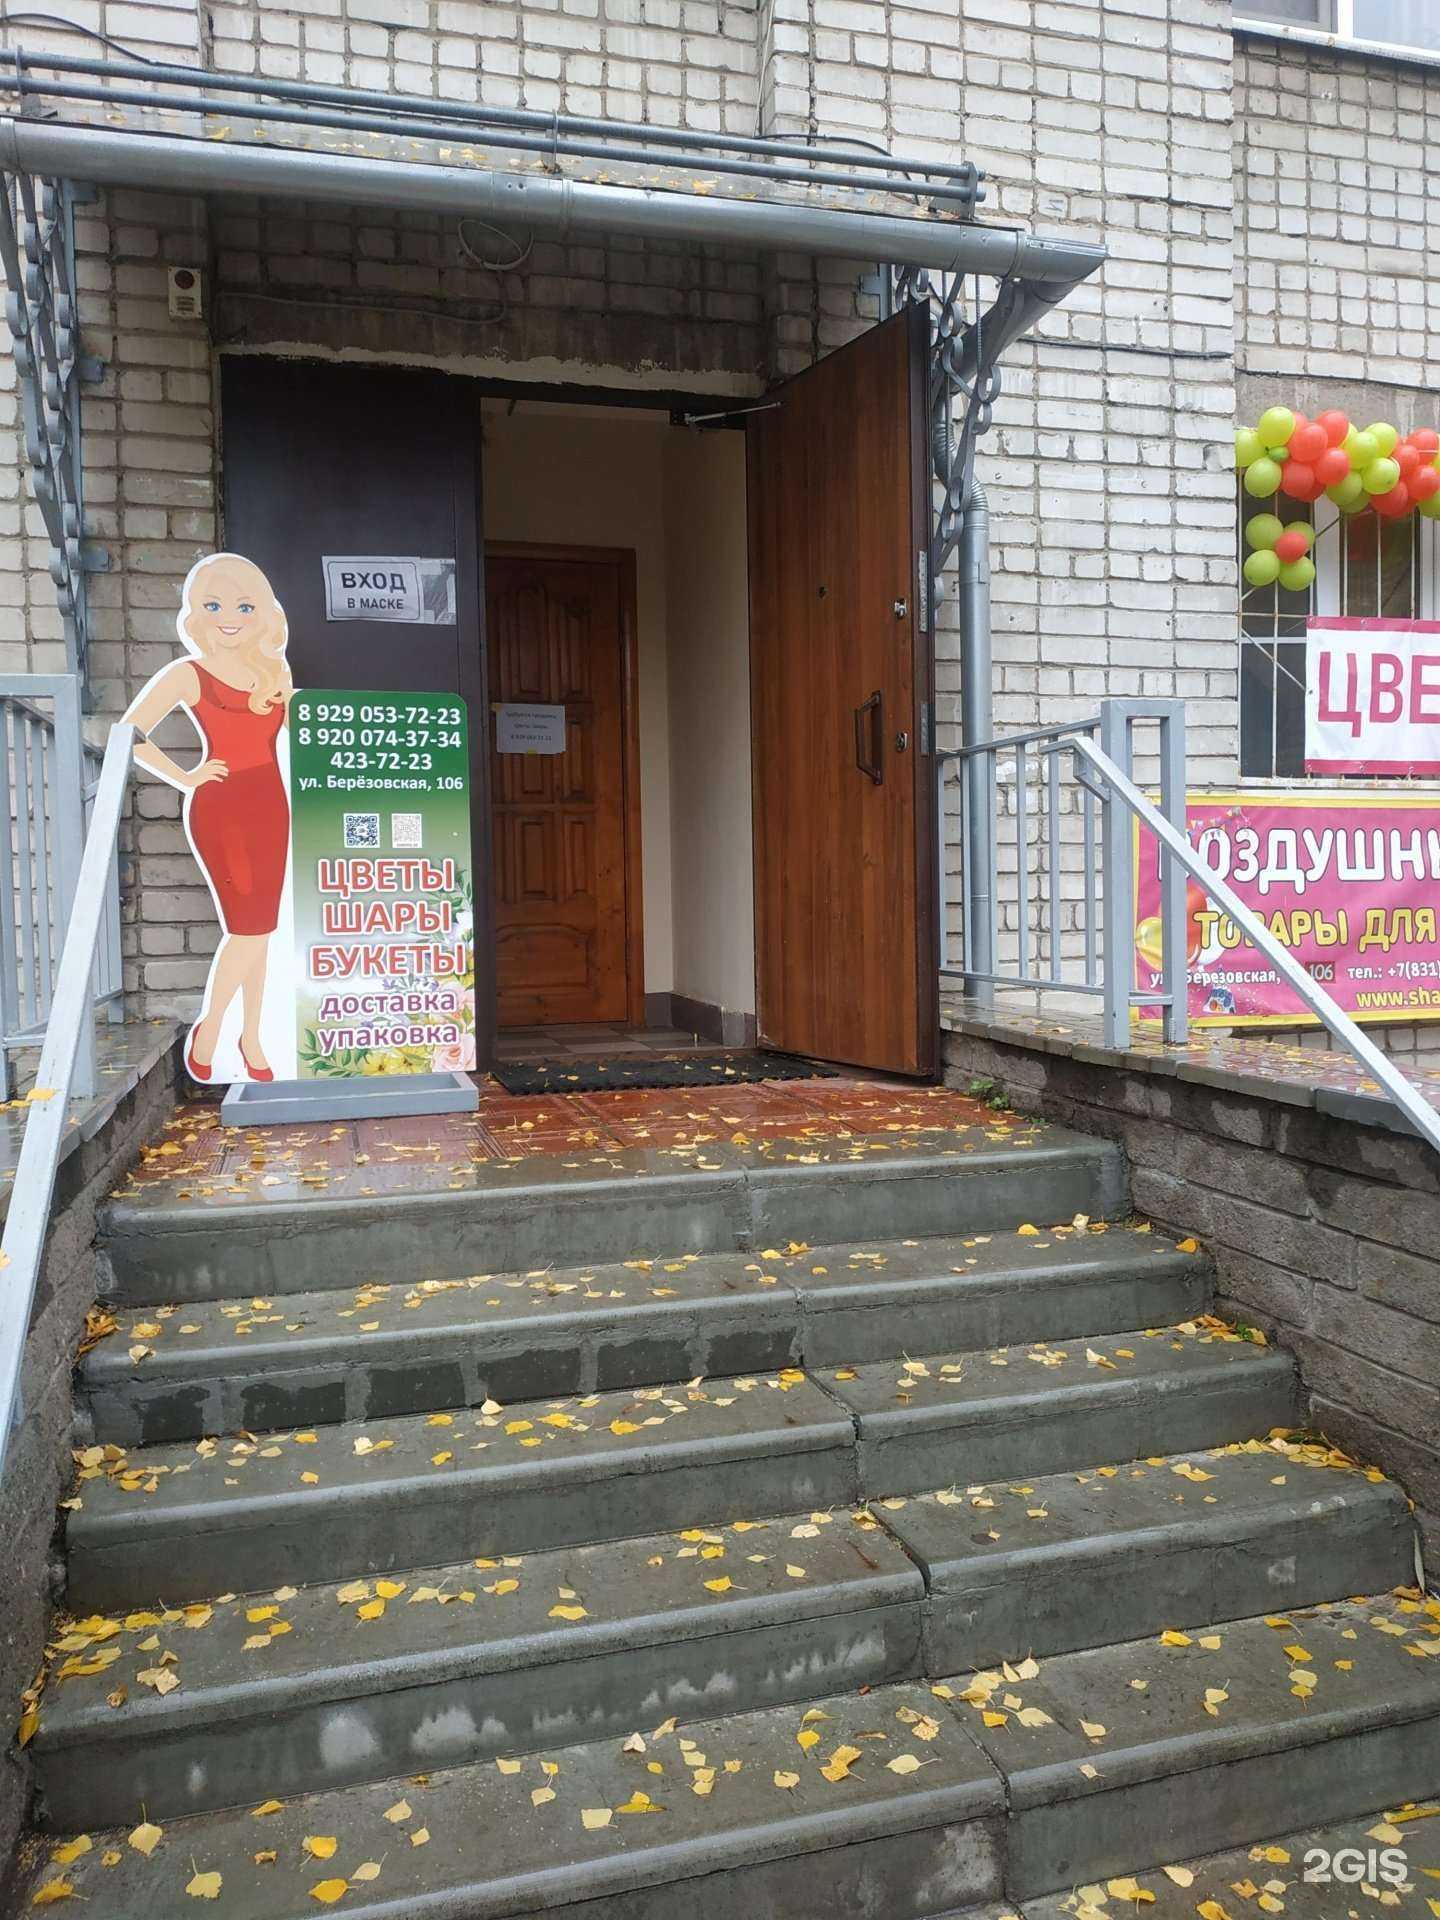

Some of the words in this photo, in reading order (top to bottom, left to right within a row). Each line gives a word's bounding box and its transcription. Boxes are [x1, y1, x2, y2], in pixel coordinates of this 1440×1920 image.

[341, 572, 406, 594] ВХОД
[347, 598, 356, 609] В
[360, 598, 404, 610] МАСКЕ
[1318, 650, 1440, 738] ЦВЕ
[298, 704, 311, 721] 8
[317, 704, 354, 722] 929
[360, 706, 461, 725] 053-72-23
[298, 728, 311, 745] 8
[317, 728, 355, 746] 920
[360, 729, 461, 748] 074-37-34
[330, 752, 432, 770] 423-72-23
[299, 777, 322, 790] ул.
[327, 775, 432, 791] Берёзовская,
[436, 776, 464, 790] 106
[1158, 827, 1440, 895] ОЗДУШН
[318, 859, 454, 898] ЦВЕТЫ
[323, 902, 451, 934] ШАРЫ
[1357, 907, 1438, 953] ДЛЯ
[311, 945, 465, 977] БУКЕТЫ
[1308, 963, 1334, 981] 106
[1347, 967, 1383, 979] тел.:
[320, 993, 455, 1021] доставка
[319, 1025, 458, 1054] упаковка
